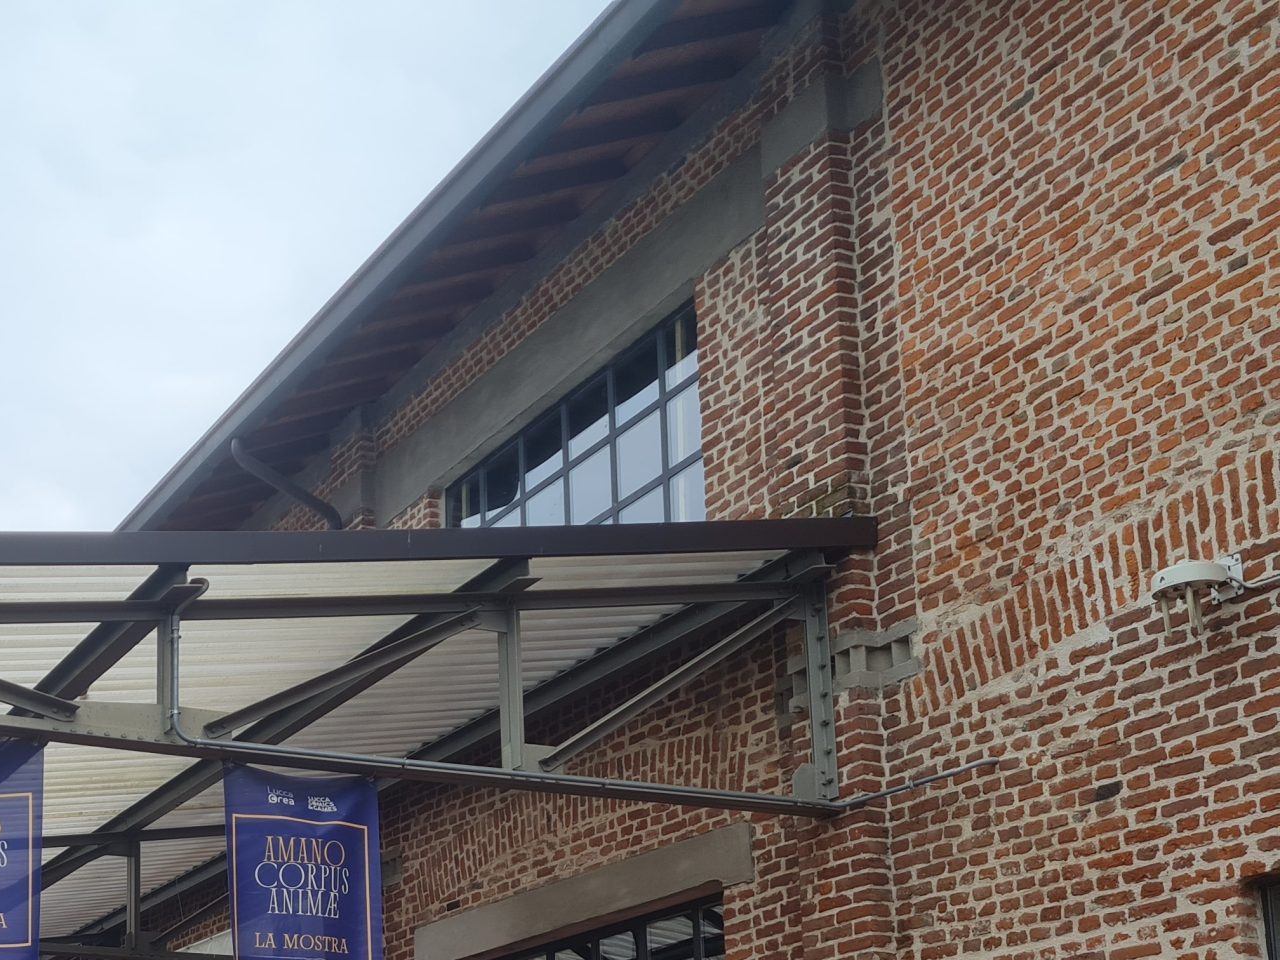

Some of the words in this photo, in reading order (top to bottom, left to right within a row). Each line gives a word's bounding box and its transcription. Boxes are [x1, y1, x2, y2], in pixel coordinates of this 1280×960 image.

[267, 785, 294, 798] Lucca
[263, 835, 345, 868] AMANO
[254, 861, 349, 894] CORPUS
[267, 888, 339, 918] ANIMÆ
[255, 932, 276, 948] LA
[283, 934, 349, 954] MOSTRA
